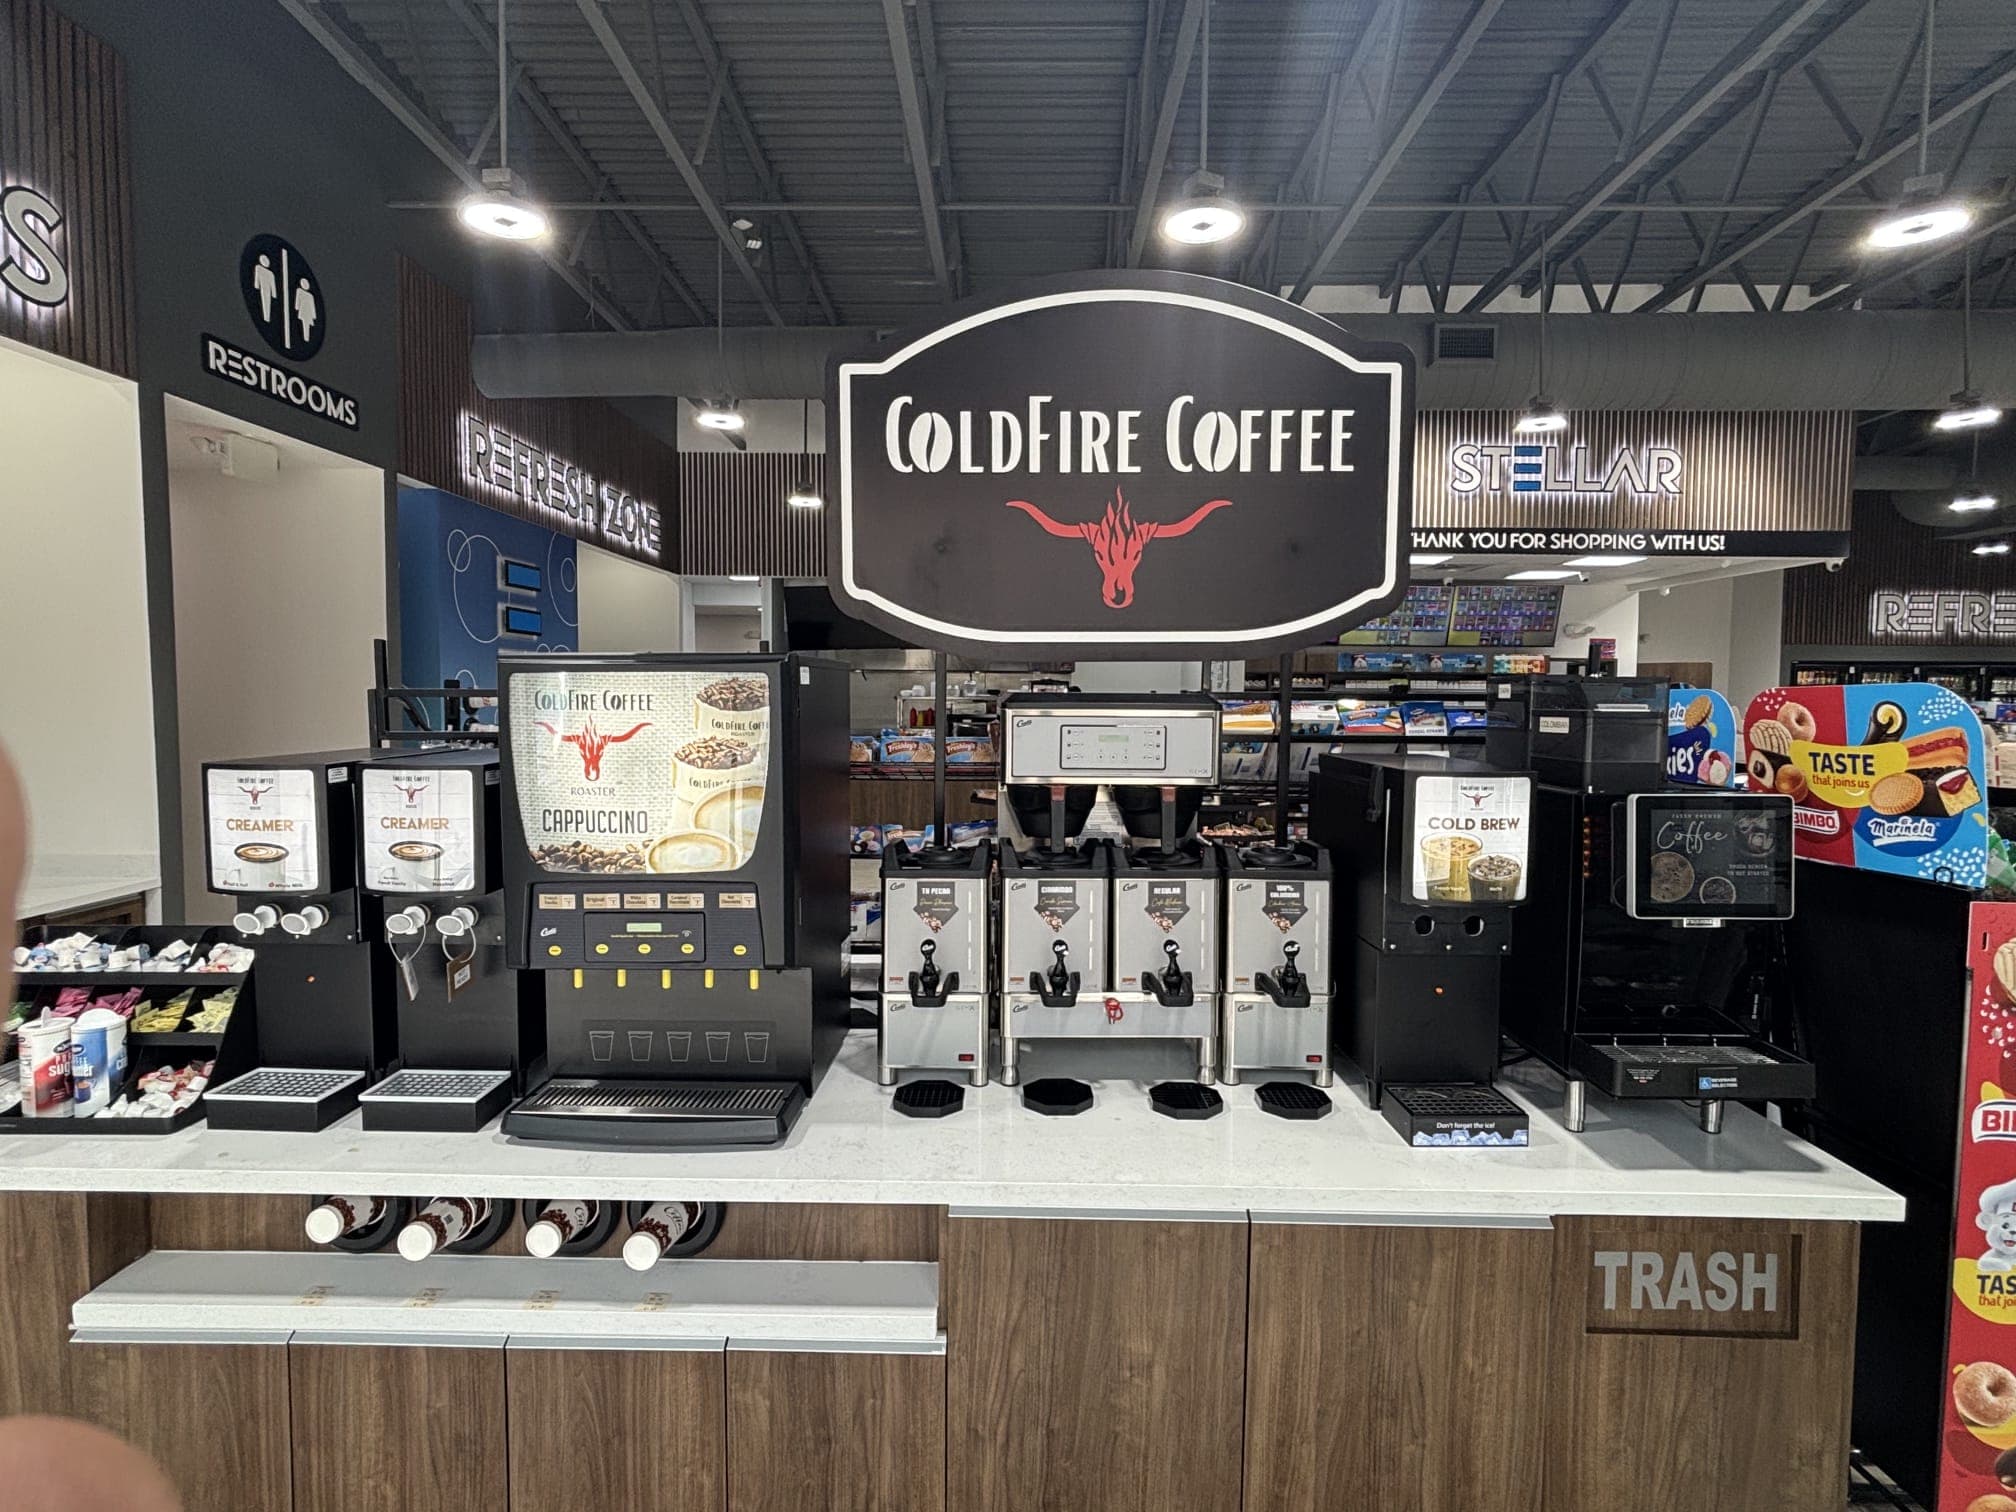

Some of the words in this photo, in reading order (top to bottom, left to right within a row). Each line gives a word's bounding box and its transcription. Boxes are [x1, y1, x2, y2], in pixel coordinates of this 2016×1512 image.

[0, 186, 68, 307] S
[208, 339, 358, 427] RESTROOMS
[885, 395, 1142, 474] COLDFIRE
[1165, 395, 1356, 473] COFFEE
[1451, 443, 1684, 494] STELLAR
[468, 416, 599, 527] REFRESH
[606, 487, 662, 551] ZONE
[1411, 532, 1463, 548] HANK
[1469, 532, 1507, 549] YOU
[1510, 533, 1546, 549] FOR
[1550, 533, 1646, 550] SHOPPING
[1651, 535, 1698, 550] WITH
[1698, 535, 1726, 550] US!
[1876, 593, 2016, 632] REFRE
[534, 689, 597, 711] COLDFIRE
[602, 689, 654, 711] COFFEE
[1808, 751, 1875, 776] TASTE
[570, 786, 616, 797] ROASTER
[1812, 774, 1831, 786] that
[1832, 776, 1857, 789] joins
[1857, 778, 1870, 788] us
[226, 818, 294, 832] CREAMER
[380, 816, 449, 830] CREAMER
[542, 808, 649, 834] CAPPUCCINO
[1428, 817, 1476, 831] COLD
[1480, 817, 1520, 831] BREW
[1869, 817, 1935, 838] Marinela
[1657, 821, 1729, 854] Coffee
[1594, 1250, 1779, 1313] TRASH
[1979, 1295, 2000, 1306] that
